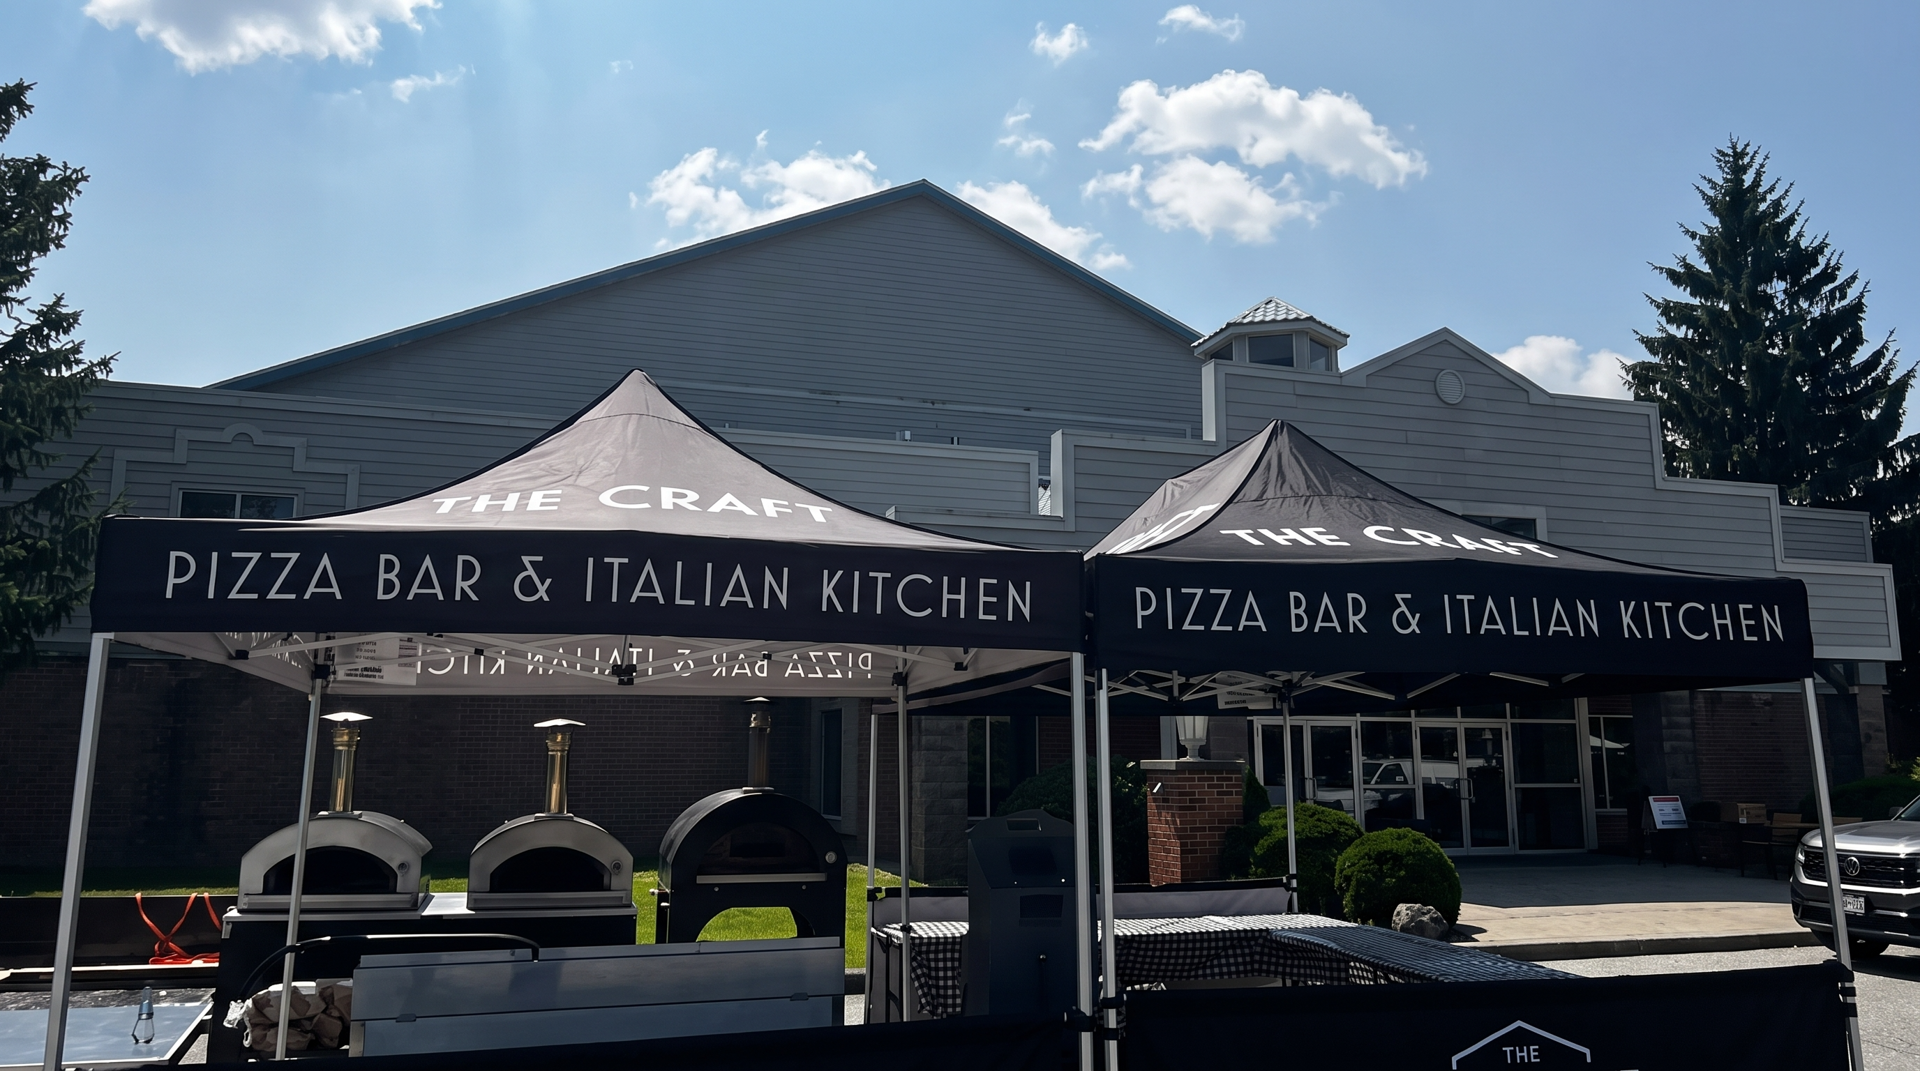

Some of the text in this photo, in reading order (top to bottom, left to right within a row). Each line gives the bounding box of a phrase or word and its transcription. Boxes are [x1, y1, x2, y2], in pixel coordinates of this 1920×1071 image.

[433, 484, 833, 524] THE CRAFT
[1218, 526, 1352, 547] THE
[1361, 524, 1560, 560] CRAFT
[165, 550, 1032, 623] PIZZA BAR & ITALIAN KITCHEN
[1135, 586, 1785, 644] PIZZA BAR & ITALIAN KITCHEN
[1502, 1045, 1541, 1064] THE
